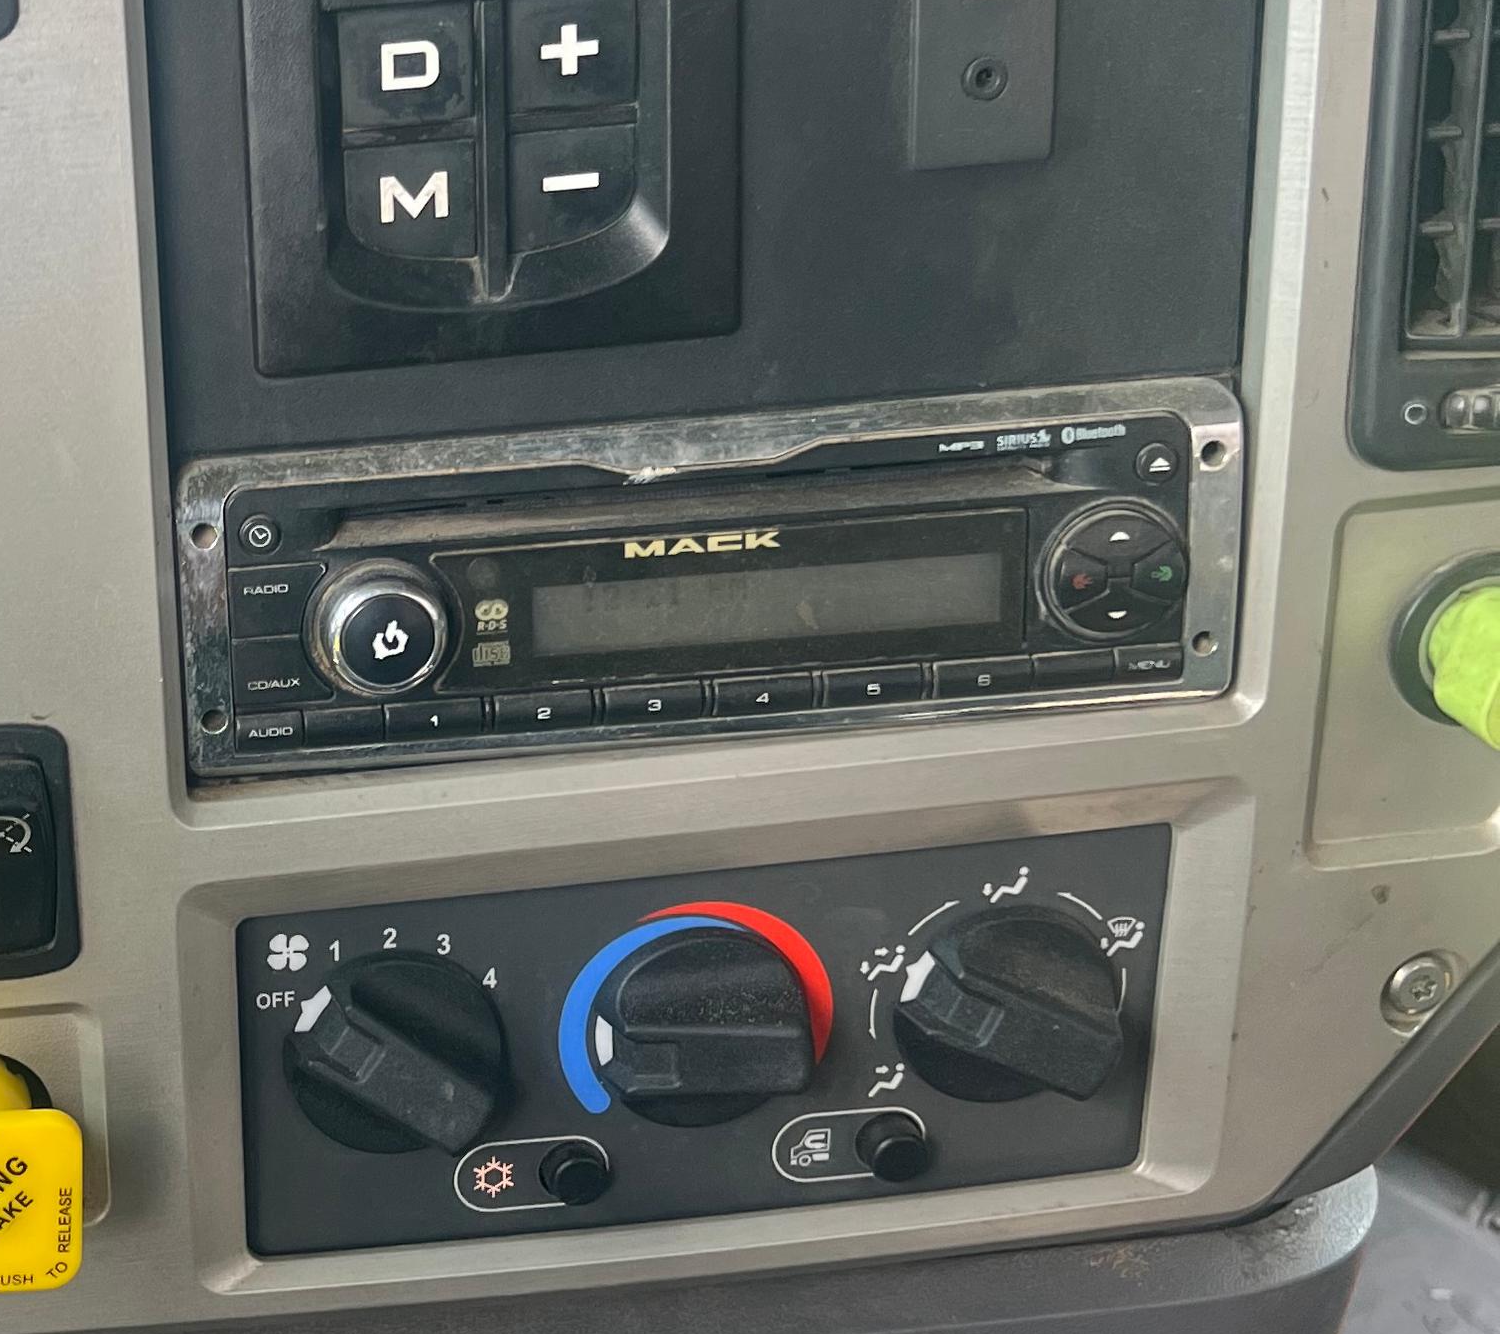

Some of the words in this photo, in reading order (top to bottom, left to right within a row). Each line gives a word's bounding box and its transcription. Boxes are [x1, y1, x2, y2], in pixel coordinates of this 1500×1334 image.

[380, 39, 441, 92] D
[540, 23, 600, 77] +
[379, 170, 450, 225] M
[623, 530, 782, 559] MACK
[243, 583, 290, 596] RADIO
[247, 677, 301, 691] CD/AUX
[429, 714, 439, 728] 1
[536, 706, 552, 720] 2
[647, 698, 662, 712] 3
[754, 691, 770, 705] 4
[866, 682, 882, 696] 5
[977, 673, 992, 687] 6
[248, 725, 294, 739] AUDIO
[328, 939, 340, 962] 1
[382, 927, 397, 949] 2
[436, 933, 451, 955] 3
[482, 966, 498, 989] 4
[255, 989, 296, 1011] OFF
[45, 1260, 68, 1280] TO
[57, 1186, 73, 1254] RELEASE
